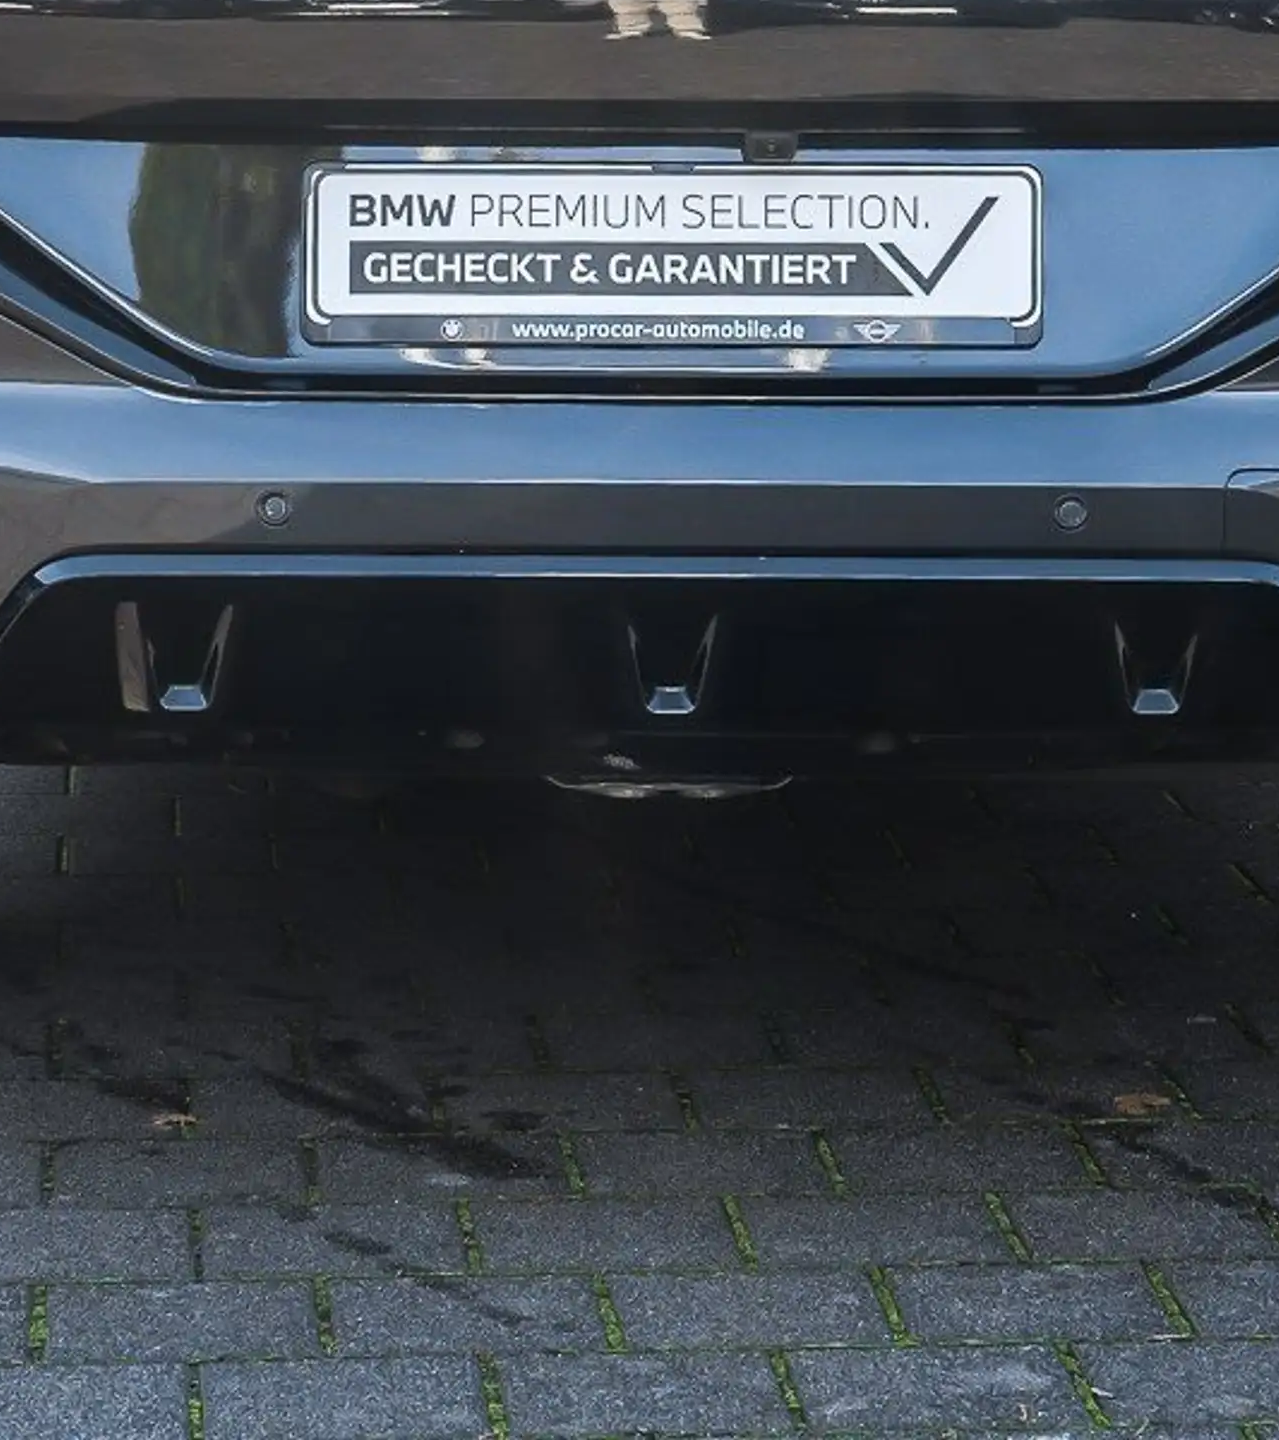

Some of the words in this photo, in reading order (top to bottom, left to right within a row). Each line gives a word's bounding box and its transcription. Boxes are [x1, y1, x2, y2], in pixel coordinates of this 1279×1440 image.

[349, 194, 456, 227] BMW
[471, 194, 666, 229] PREMIUM
[682, 194, 930, 230] SELECTION.
[363, 252, 561, 284] GECHECKT
[569, 253, 599, 284] &
[608, 253, 857, 285] GARANTIERT
[512, 320, 804, 342] www.procar-automobile.de
